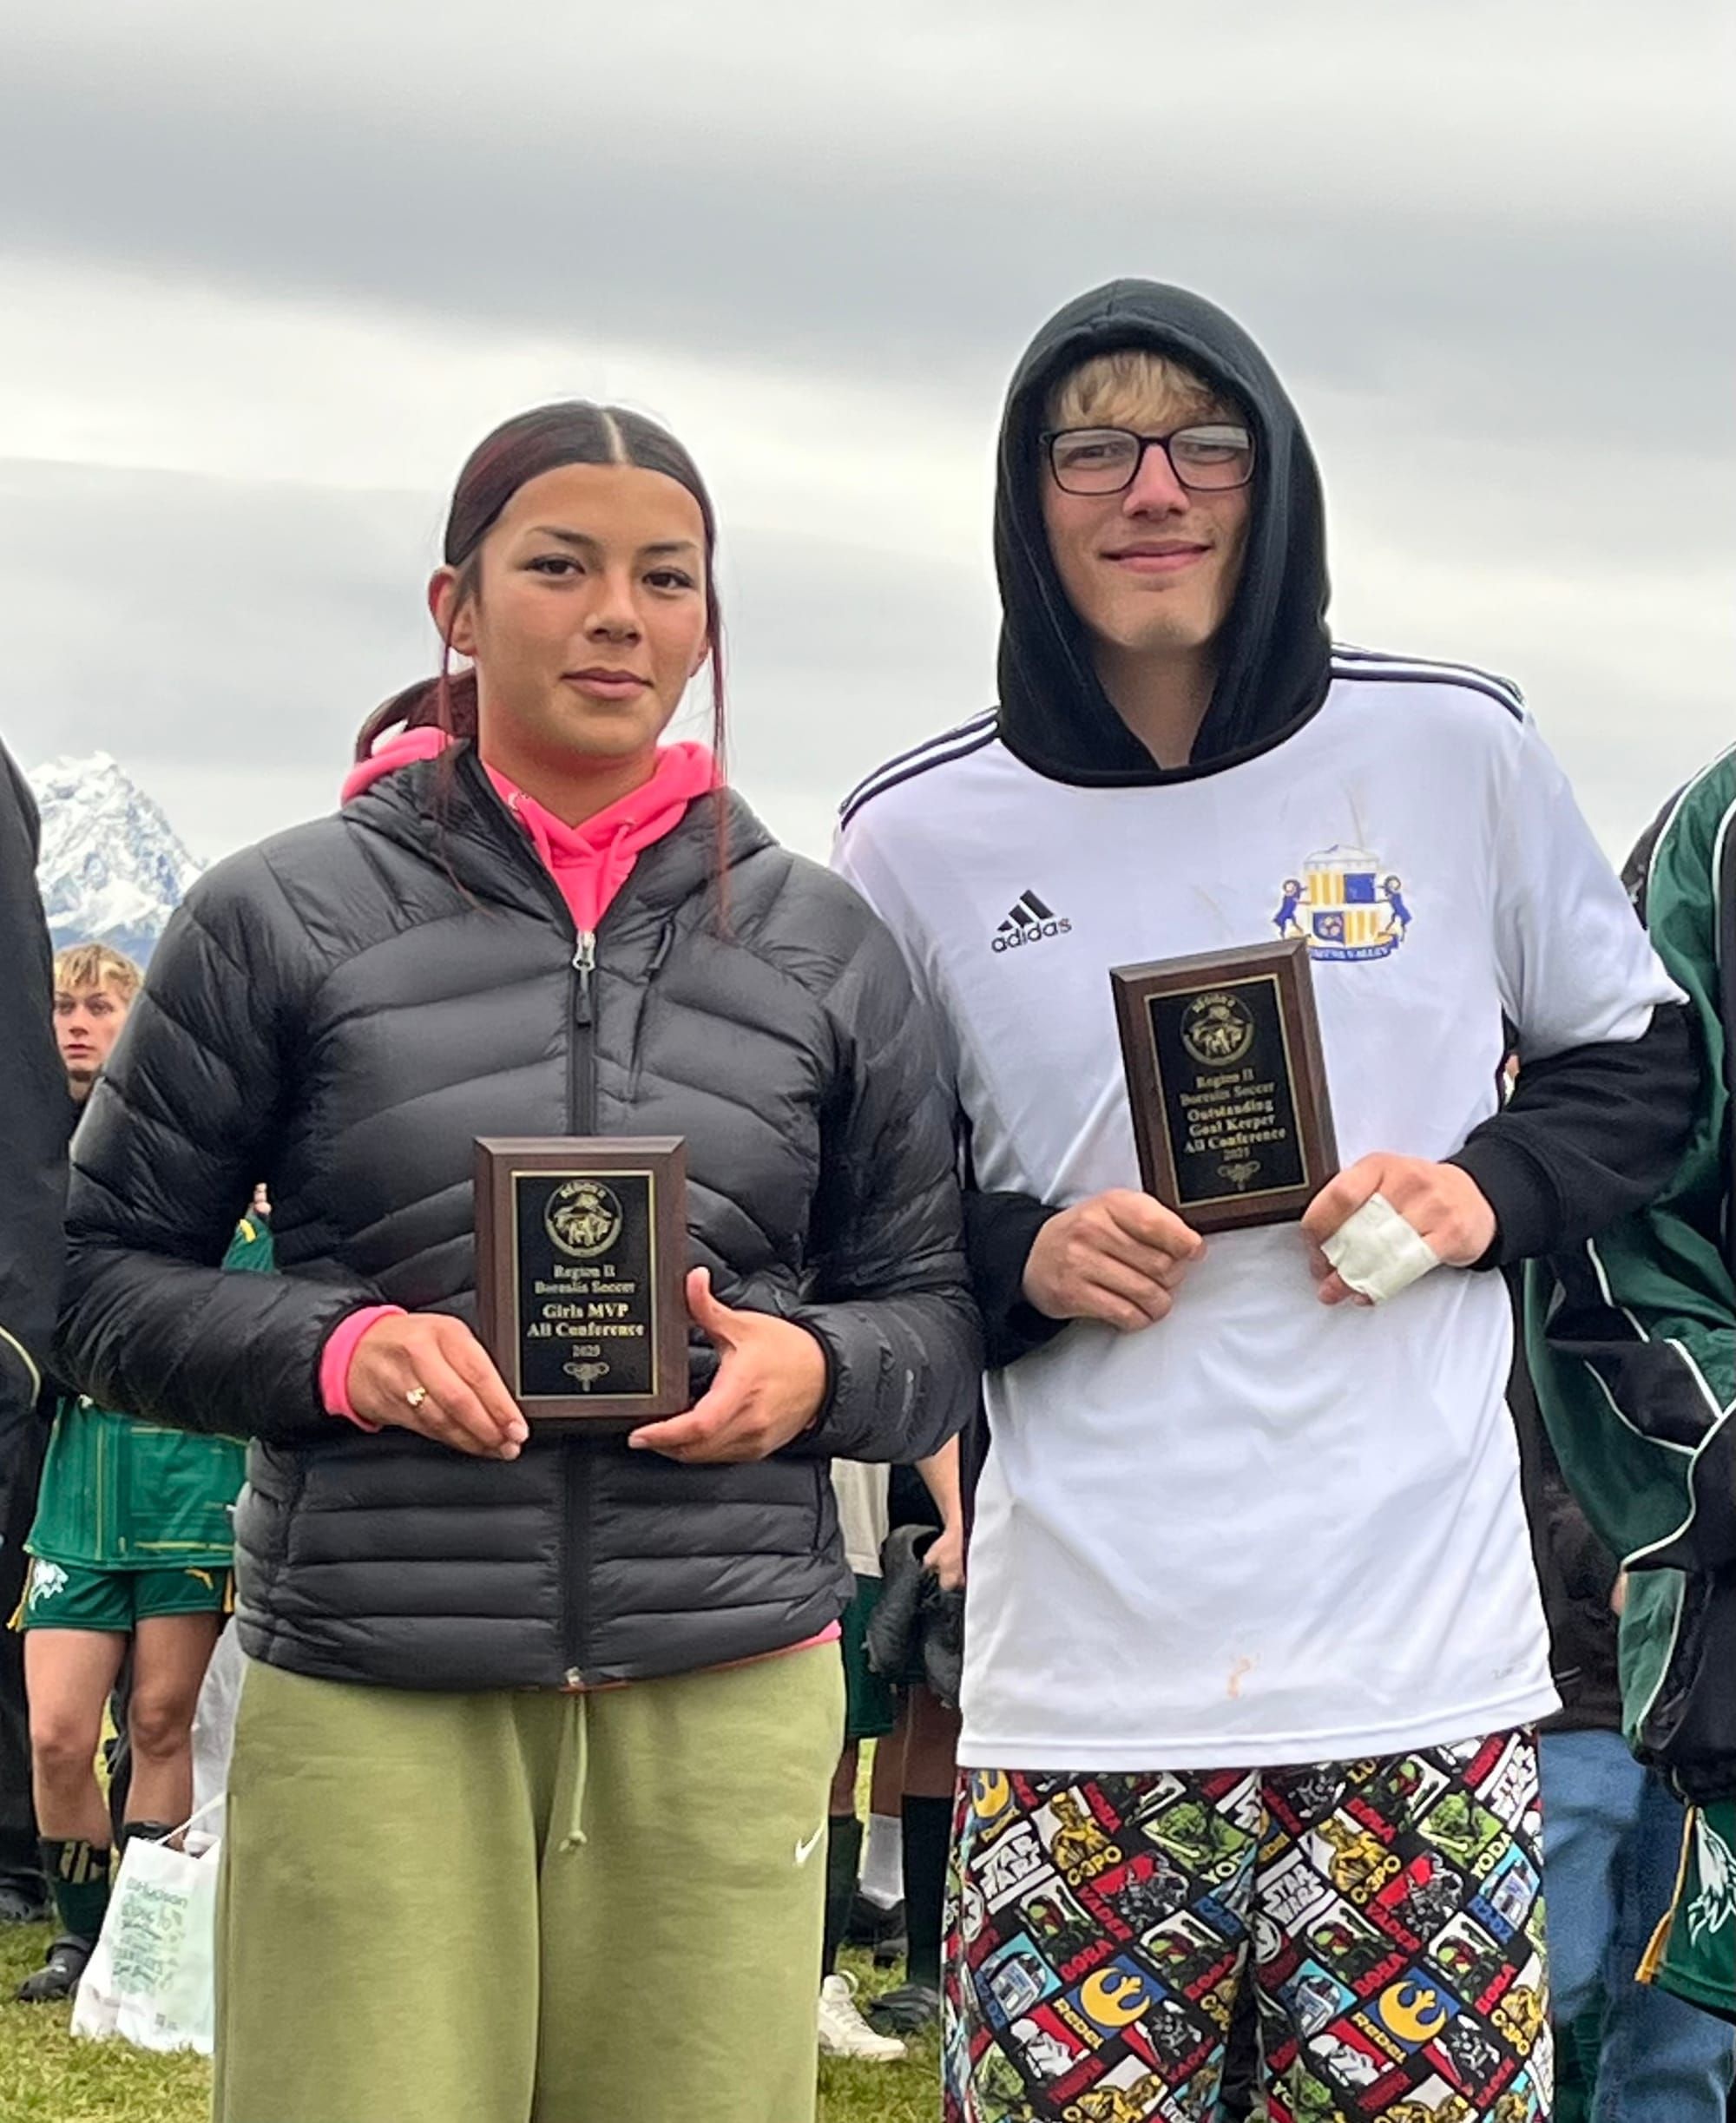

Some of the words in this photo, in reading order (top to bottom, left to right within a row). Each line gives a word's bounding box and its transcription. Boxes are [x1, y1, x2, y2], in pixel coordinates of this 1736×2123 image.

[991, 918, 1072, 953] adidas
[1187, 1098, 1274, 1122] Outstanding
[1189, 1120, 1226, 1138] Goal
[1226, 1114, 1276, 1133] Keeper
[1183, 1138, 1207, 1154] All
[1207, 1127, 1286, 1149] Conference
[542, 1304, 584, 1318] Girls
[588, 1303, 629, 1318] MVP
[527, 1323, 552, 1337] All
[556, 1322, 645, 1337] Conference
[1470, 1831, 1512, 1881] YODA
[1263, 1863, 1322, 1913] STAR
